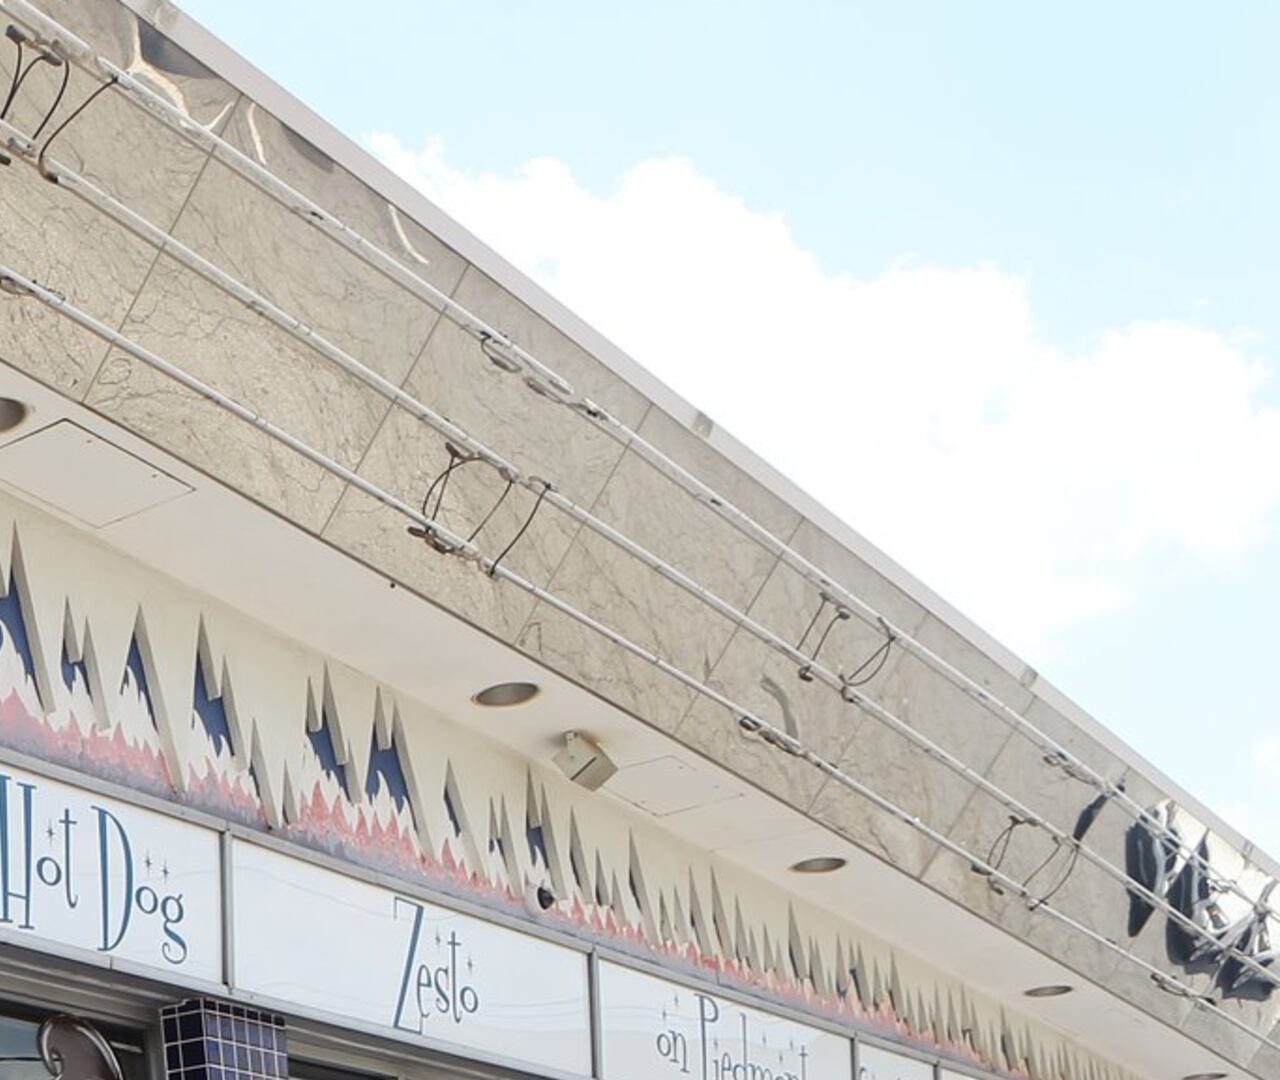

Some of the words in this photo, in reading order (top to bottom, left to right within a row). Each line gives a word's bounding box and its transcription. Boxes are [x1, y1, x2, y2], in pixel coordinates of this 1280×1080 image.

[90, 805, 188, 964] Dog
[393, 895, 479, 1035] Zesto
[656, 1030, 690, 1073] on
